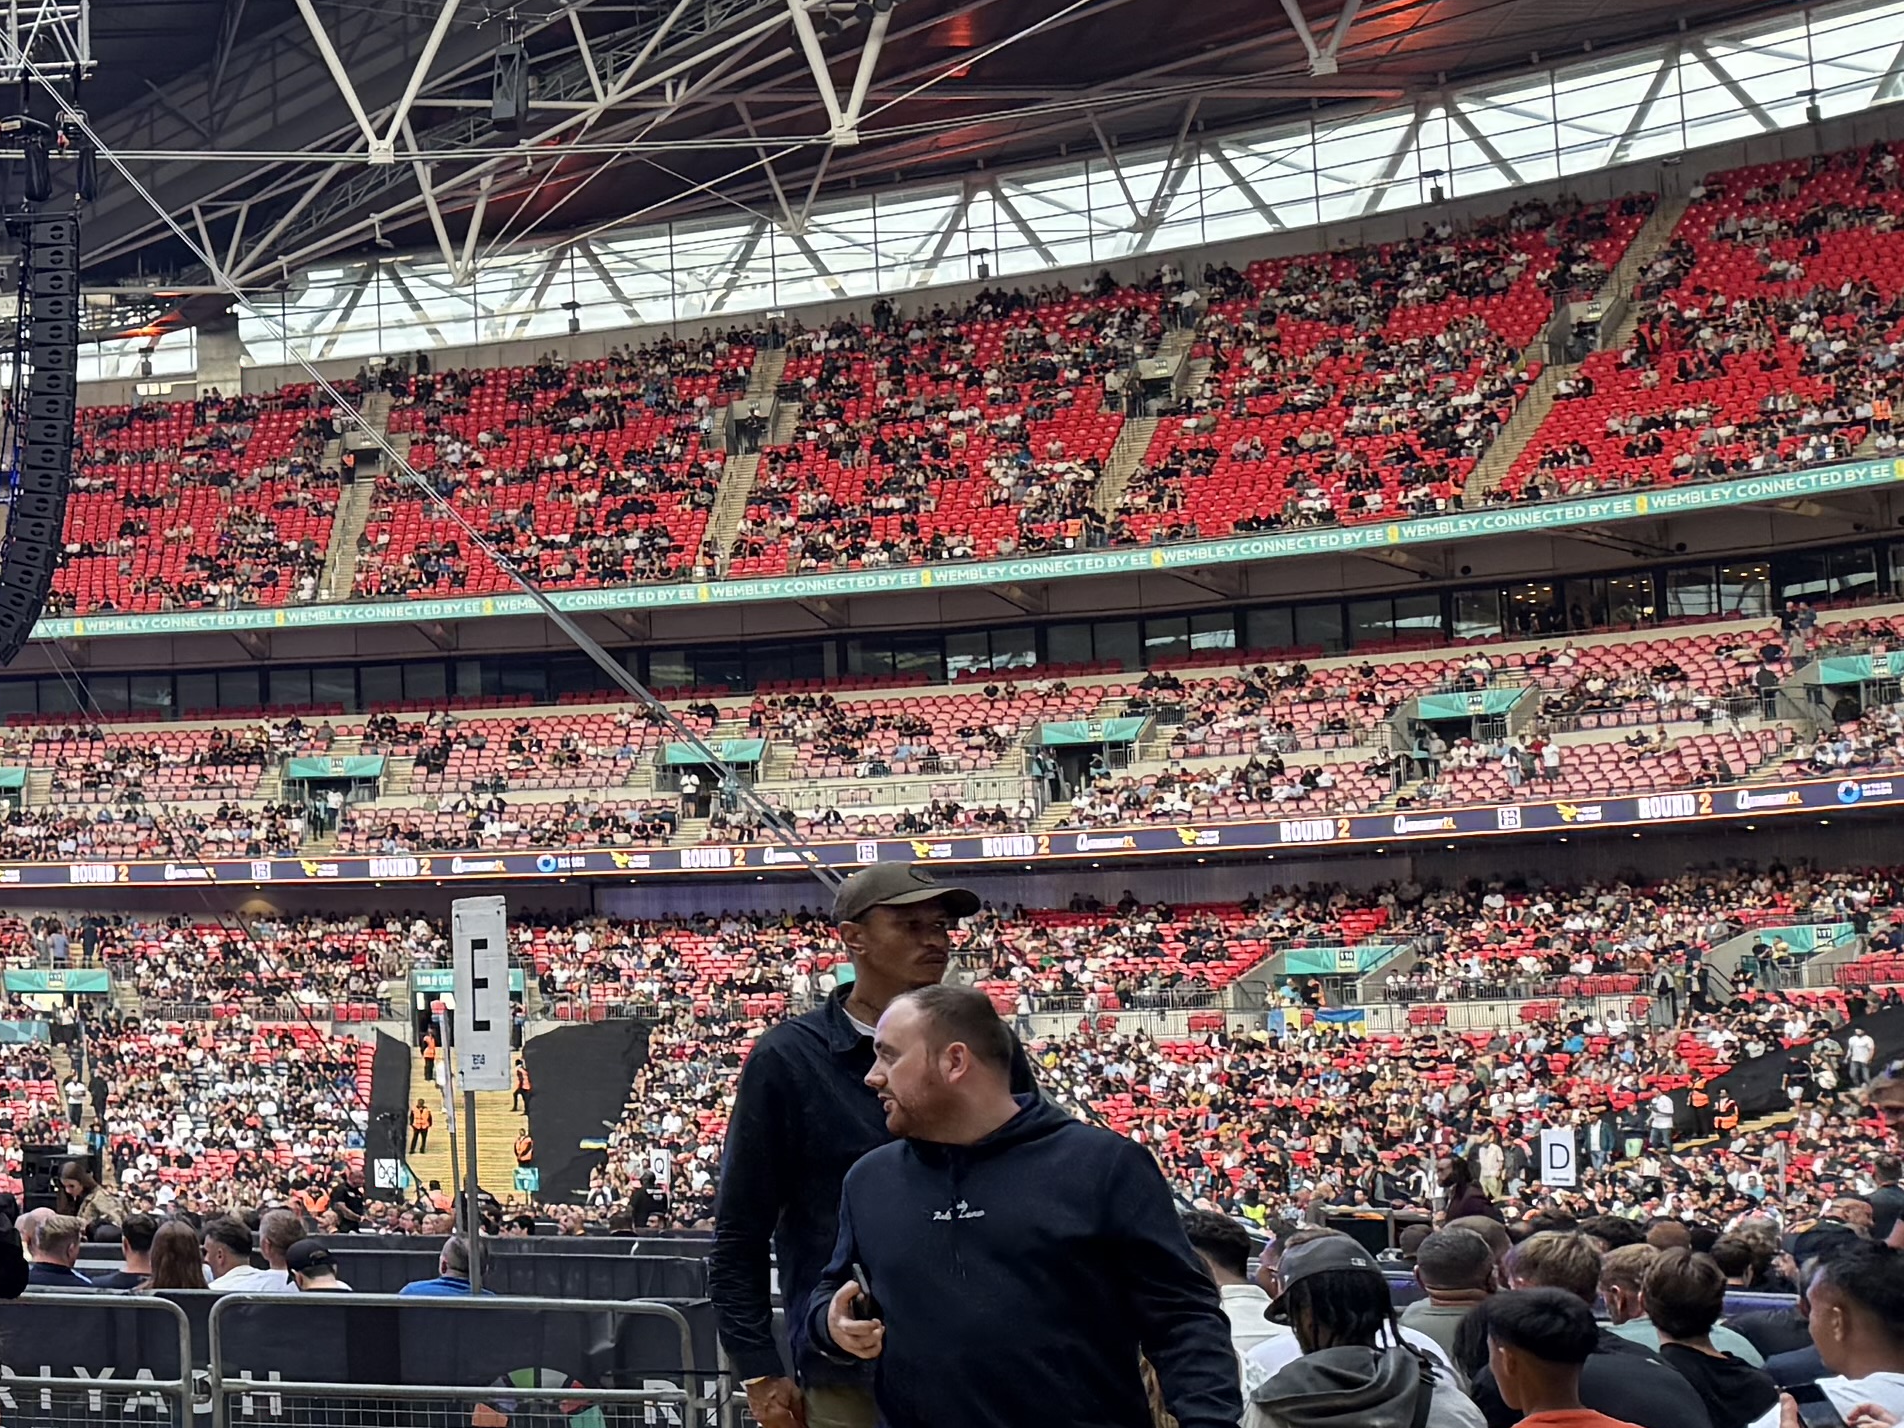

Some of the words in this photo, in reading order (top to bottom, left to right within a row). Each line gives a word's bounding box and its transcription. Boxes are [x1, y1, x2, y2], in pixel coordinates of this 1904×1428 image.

[1652, 486, 1730, 509] WEMBLEY
[1736, 471, 1842, 498] CONNECTED
[1846, 467, 1864, 482] BY
[1870, 464, 1890, 478] EE
[1402, 518, 1478, 538] WEMBLEY
[1482, 505, 1586, 529] CONNECTED
[1591, 502, 1610, 516] BY
[1613, 499, 1632, 514] EE
[1162, 544, 1236, 563] WEMBLEY
[1242, 533, 1340, 555] CONNECTED
[1342, 531, 1362, 545] BY
[1366, 529, 1384, 542] EE
[934, 565, 1006, 583] WEMBLEY
[1009, 557, 1104, 577] CONNECTED
[1106, 555, 1128, 568] BY
[1130, 553, 1148, 566] EE
[566, 591, 656, 608] CONNECTED
[658, 589, 676, 602] BY
[678, 588, 694, 601] EE
[712, 582, 780, 598] WEMBLEY
[784, 575, 876, 594] CONNECTED
[878, 573, 896, 587] BY
[900, 572, 916, 585] EE
[86, 618, 148, 633] WEMBLEY
[151, 614, 234, 630] CONNECTED
[236, 613, 254, 626] BY
[257, 612, 272, 625] EE
[288, 608, 354, 623] WEMBLEY
[354, 603, 440, 620] CONNECTED
[443, 602, 462, 615] BY
[464, 601, 480, 614] EE
[1638, 794, 1696, 819] ROUND
[1698, 792, 1713, 814] 2
[1280, 819, 1334, 842] ROUND
[1336, 818, 1350, 839] 2
[680, 848, 730, 868] ROUND
[732, 847, 746, 866] 2
[982, 836, 1035, 857] ROUND
[1036, 835, 1050, 854] 2
[471, 938, 490, 1031] E
[1549, 1143, 1570, 1169] D
